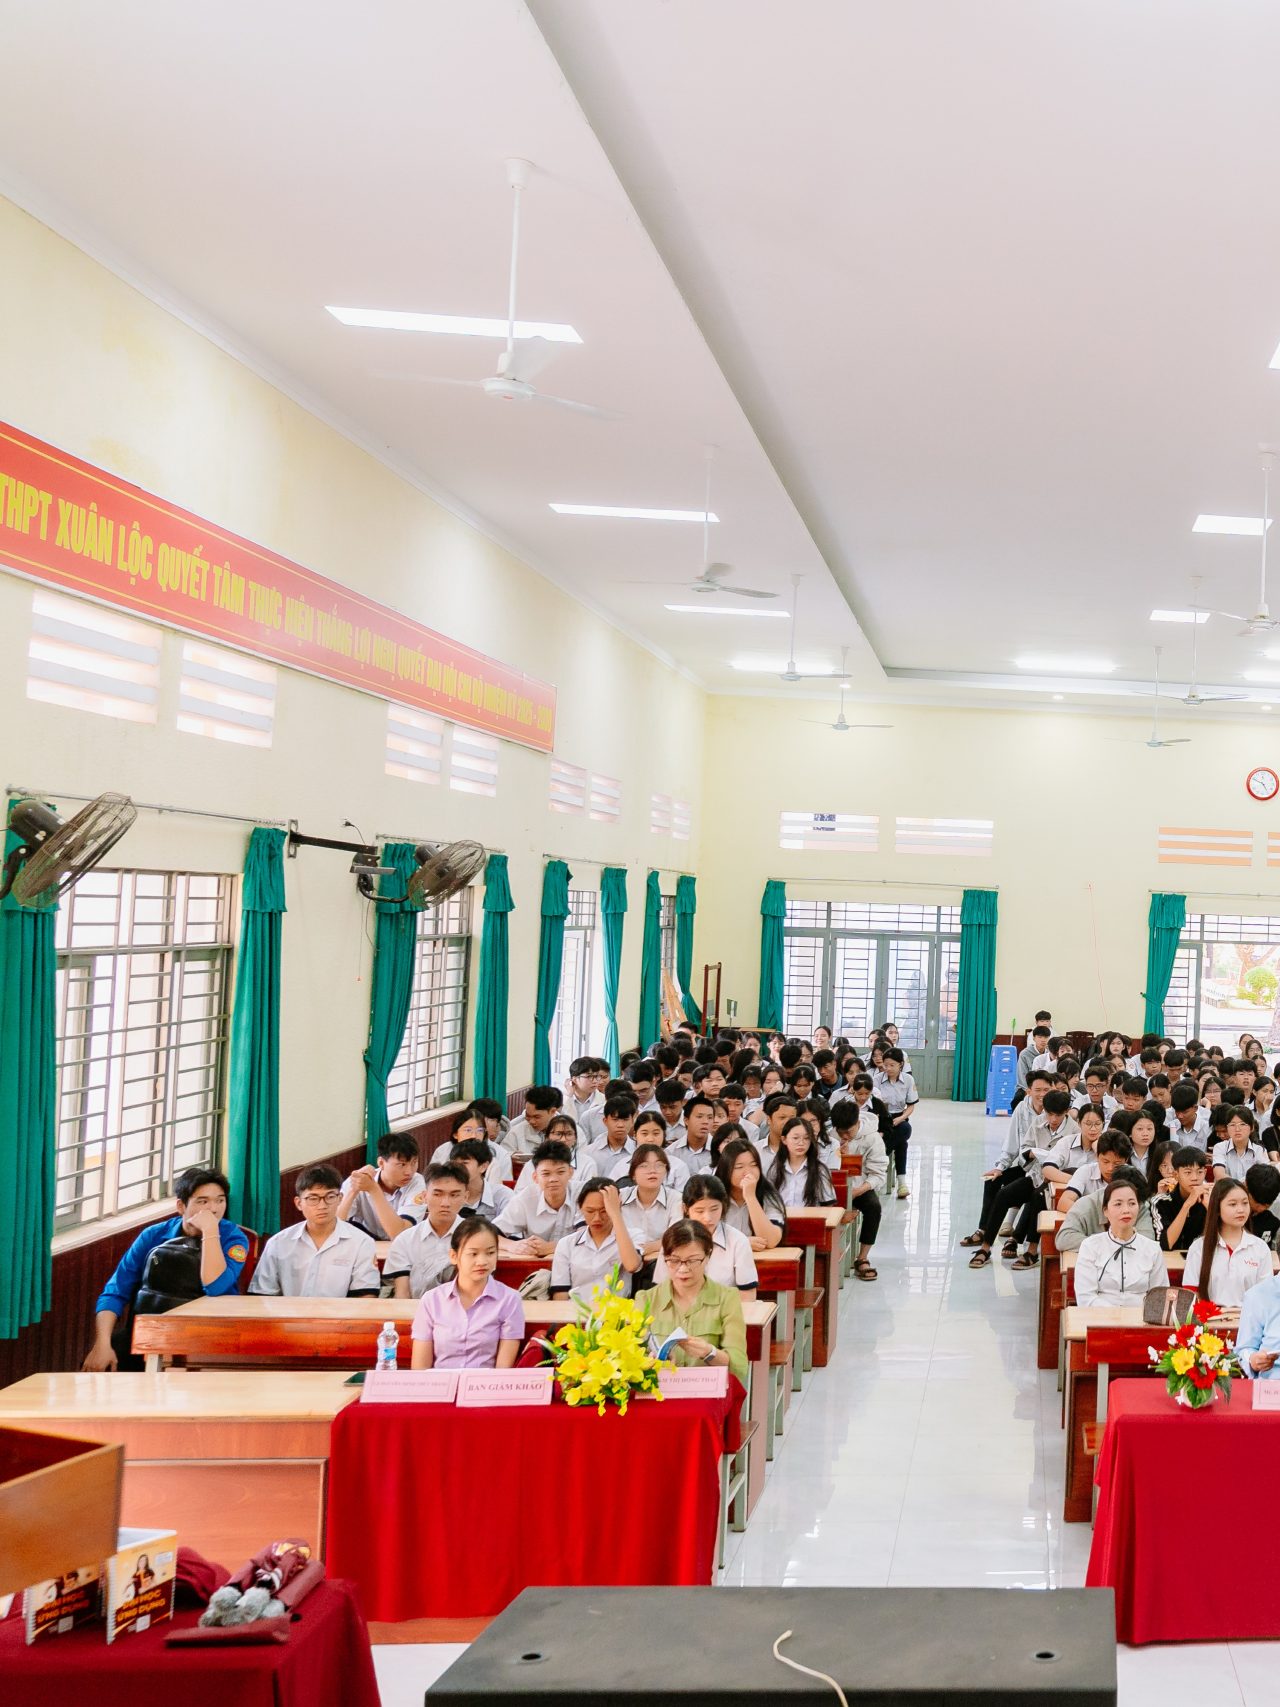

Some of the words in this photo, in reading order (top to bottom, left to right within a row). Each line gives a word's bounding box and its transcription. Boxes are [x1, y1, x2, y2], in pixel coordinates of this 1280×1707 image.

[55, 500, 115, 565] XUÂN
[117, 521, 154, 585] LỘC
[157, 544, 209, 602] QUYẾT
[212, 560, 245, 616] TÂM
[248, 582, 282, 633] THỰC
[468, 1384, 487, 1392] BAN
